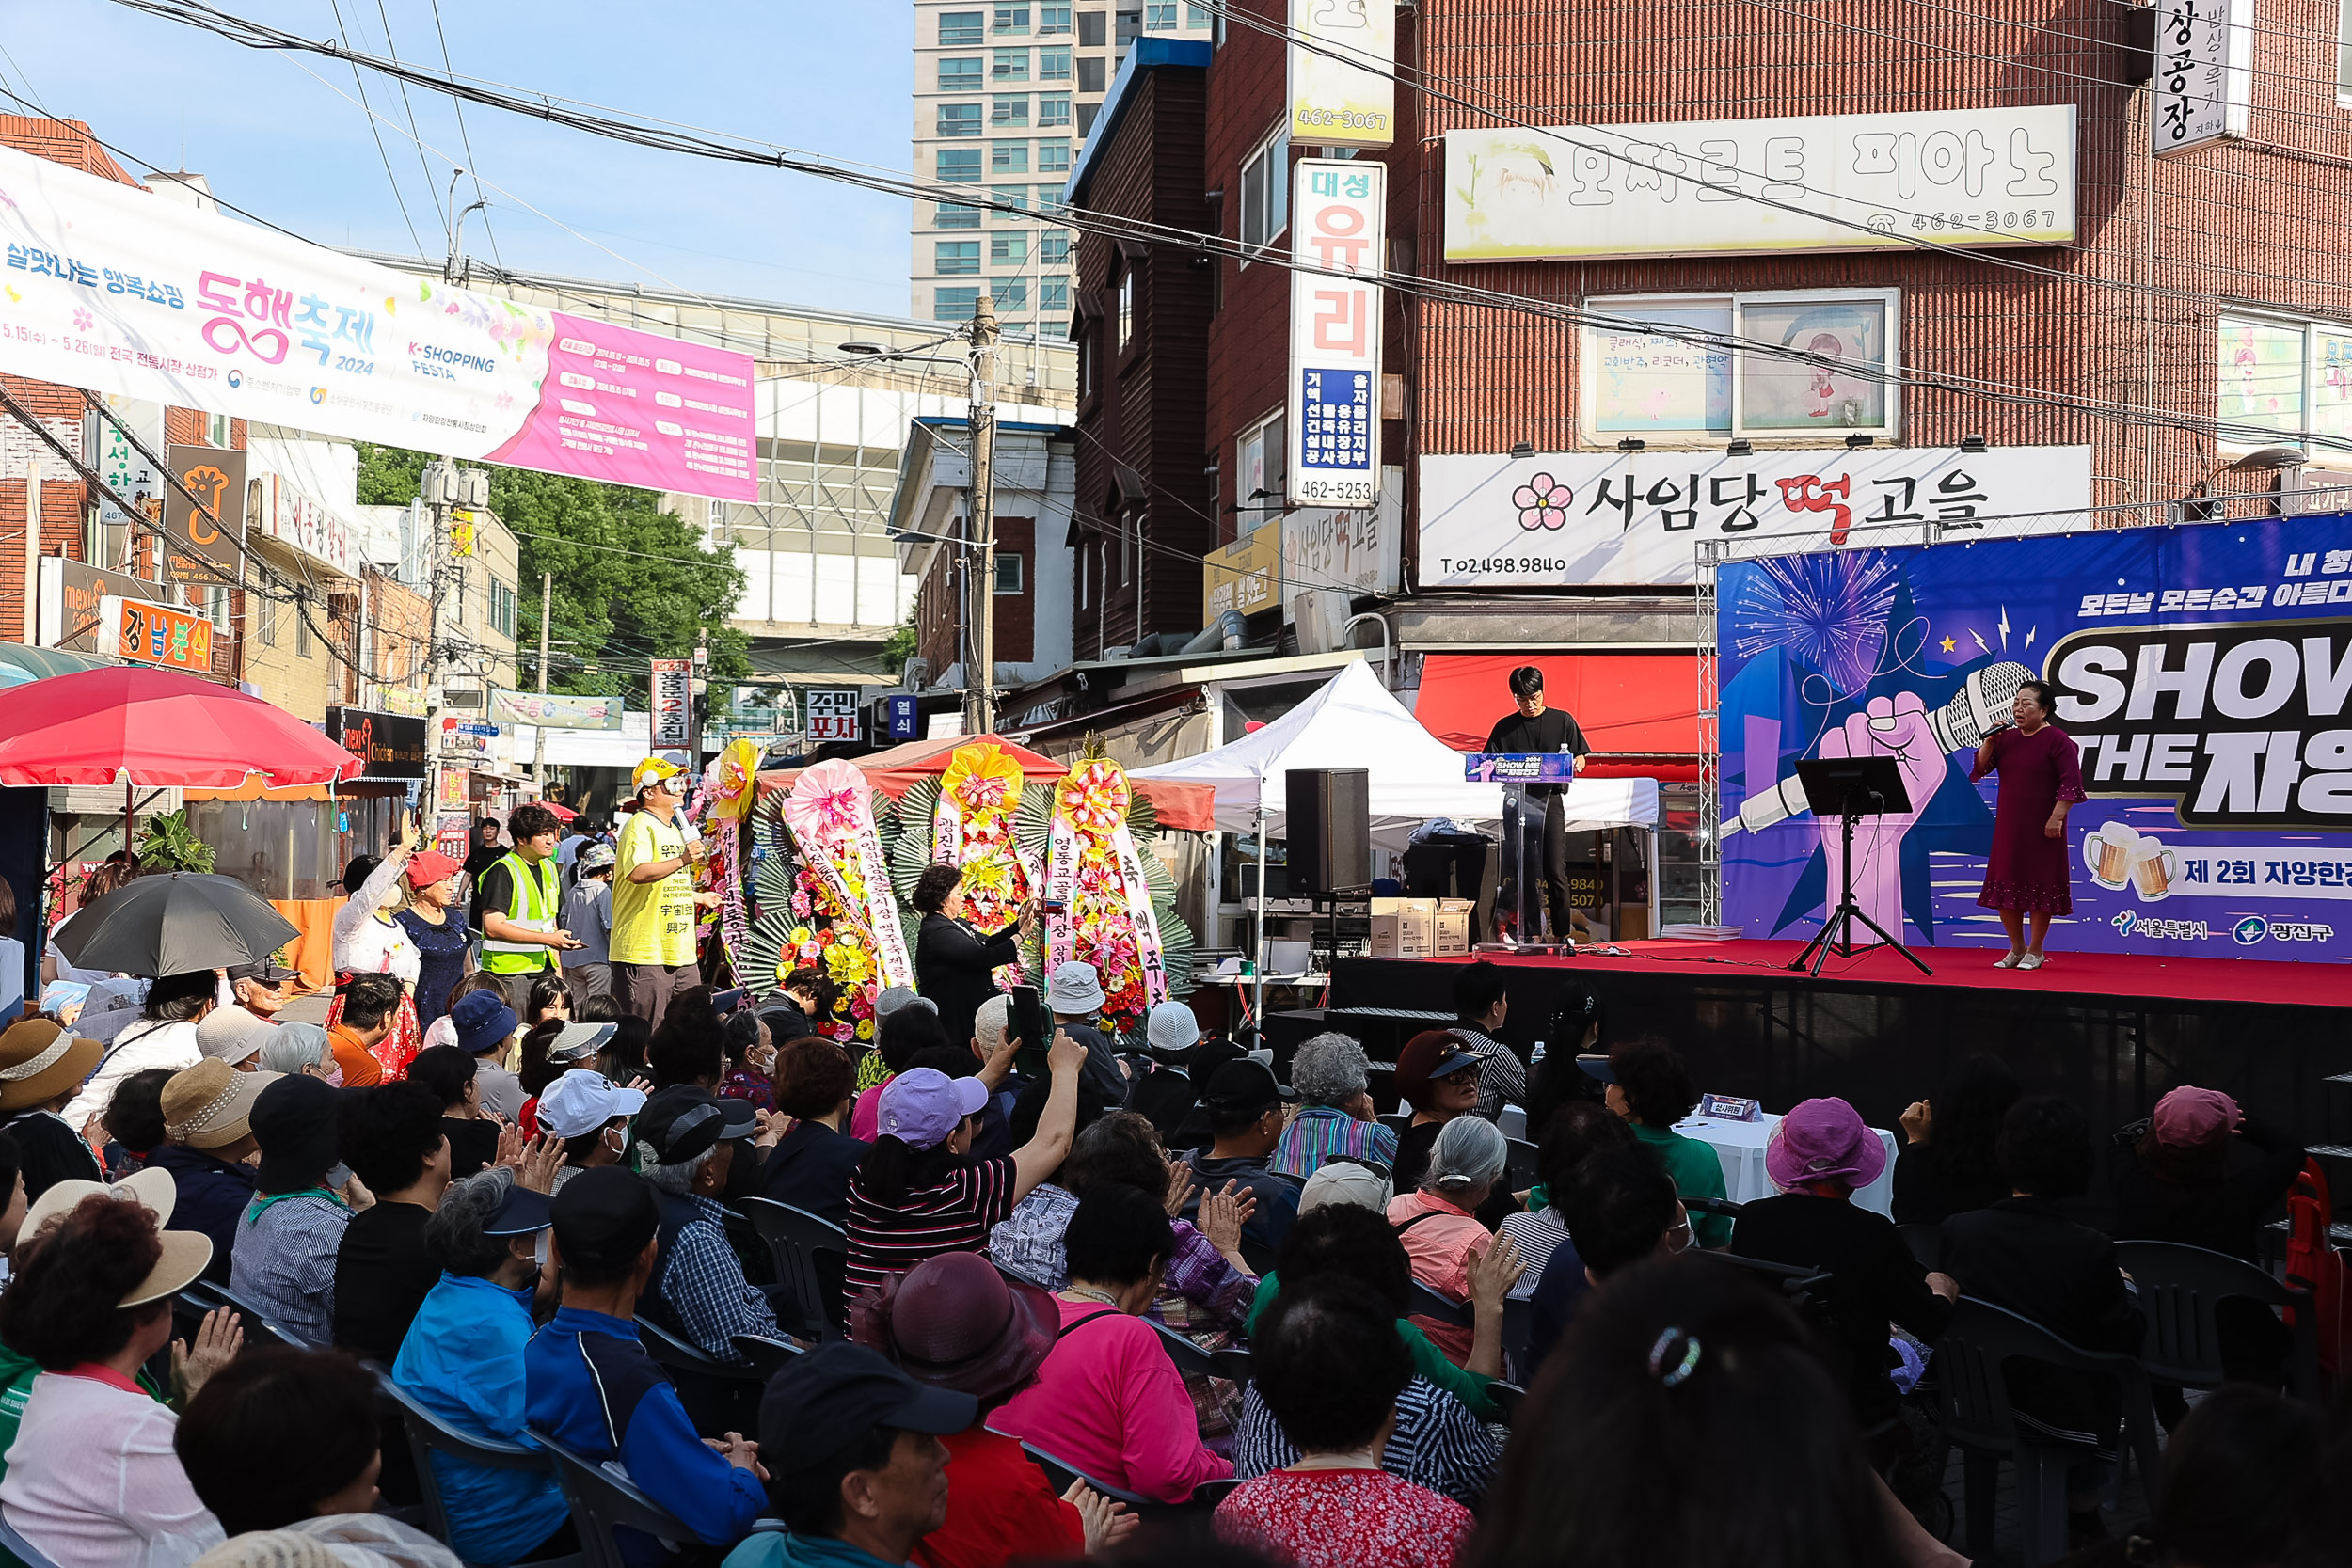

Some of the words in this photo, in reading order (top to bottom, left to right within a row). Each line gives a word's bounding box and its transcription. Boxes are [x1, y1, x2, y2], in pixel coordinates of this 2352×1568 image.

[1298, 109, 1386, 130] 462-3067
[2195, 120, 2214, 134] 지하
[1568, 137, 1806, 206] 모짜르트
[1852, 128, 2058, 199] 피아노
[1311, 173, 1369, 198] 대성
[1911, 210, 2056, 231] 462-3067
[7, 243, 98, 288] 살맛나는
[103, 267, 185, 309] 행복쇼핑
[1311, 205, 1367, 357] 유리
[110, 346, 134, 364] 전국
[335, 356, 375, 376] 2024
[408, 341, 495, 373] K-SHOPPING
[1652, 356, 1690, 368] 리코더,
[1693, 354, 1729, 370] 관현악
[412, 360, 456, 381] FESTA
[1302, 481, 1372, 499] 462-5253
[1440, 557, 1566, 574] T.02.498.9840
[2284, 553, 2314, 578] 내
[2319, 549, 2352, 575] 청
[2077, 591, 2154, 618] 모든날
[2158, 585, 2268, 612] 모든순간
[124, 608, 209, 666] 강남분식
[810, 693, 856, 716] 주민
[810, 717, 857, 739] 포차
[897, 701, 911, 733] 열쇠
[2073, 734, 2198, 782] THE
[2185, 860, 2209, 886] 제
[2217, 860, 2257, 886] 2회
[2135, 918, 2209, 940] 서울특별시
[2270, 922, 2333, 941] 광진구
[1715, 1103, 1740, 1115] 심사위원
